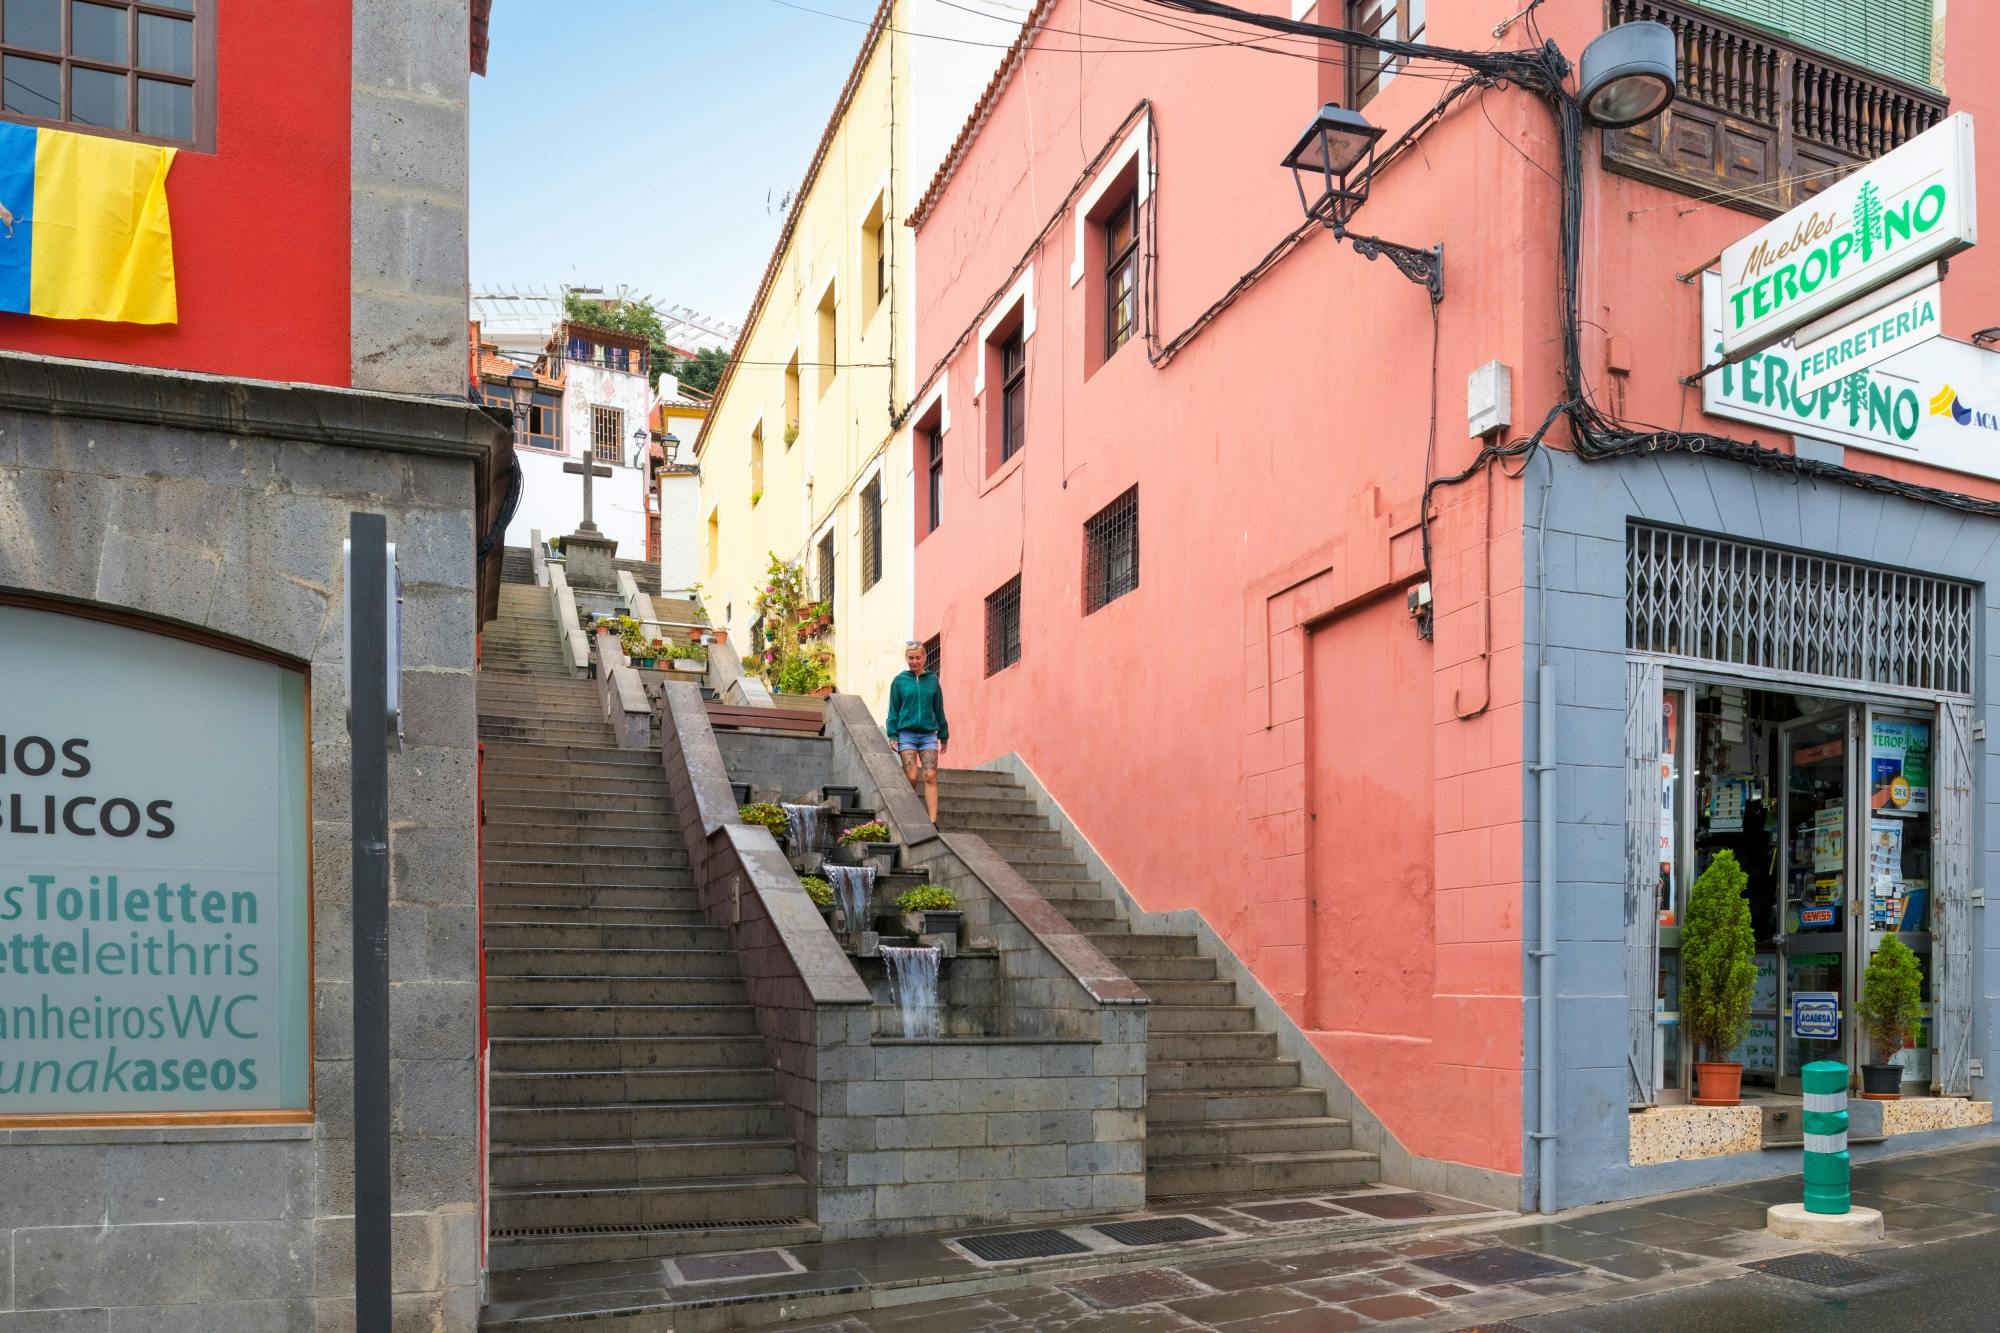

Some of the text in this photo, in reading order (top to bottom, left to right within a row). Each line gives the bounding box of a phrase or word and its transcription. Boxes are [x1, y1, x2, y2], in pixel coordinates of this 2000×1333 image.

[1740, 211, 1837, 285] Muebles
[1801, 301, 1935, 382] FERRETERÍA
[1974, 411, 2000, 431] ACA
[0, 734, 91, 778] OS
[0, 794, 175, 839] LICOS
[1801, 1013, 1831, 1023] ACADESA
